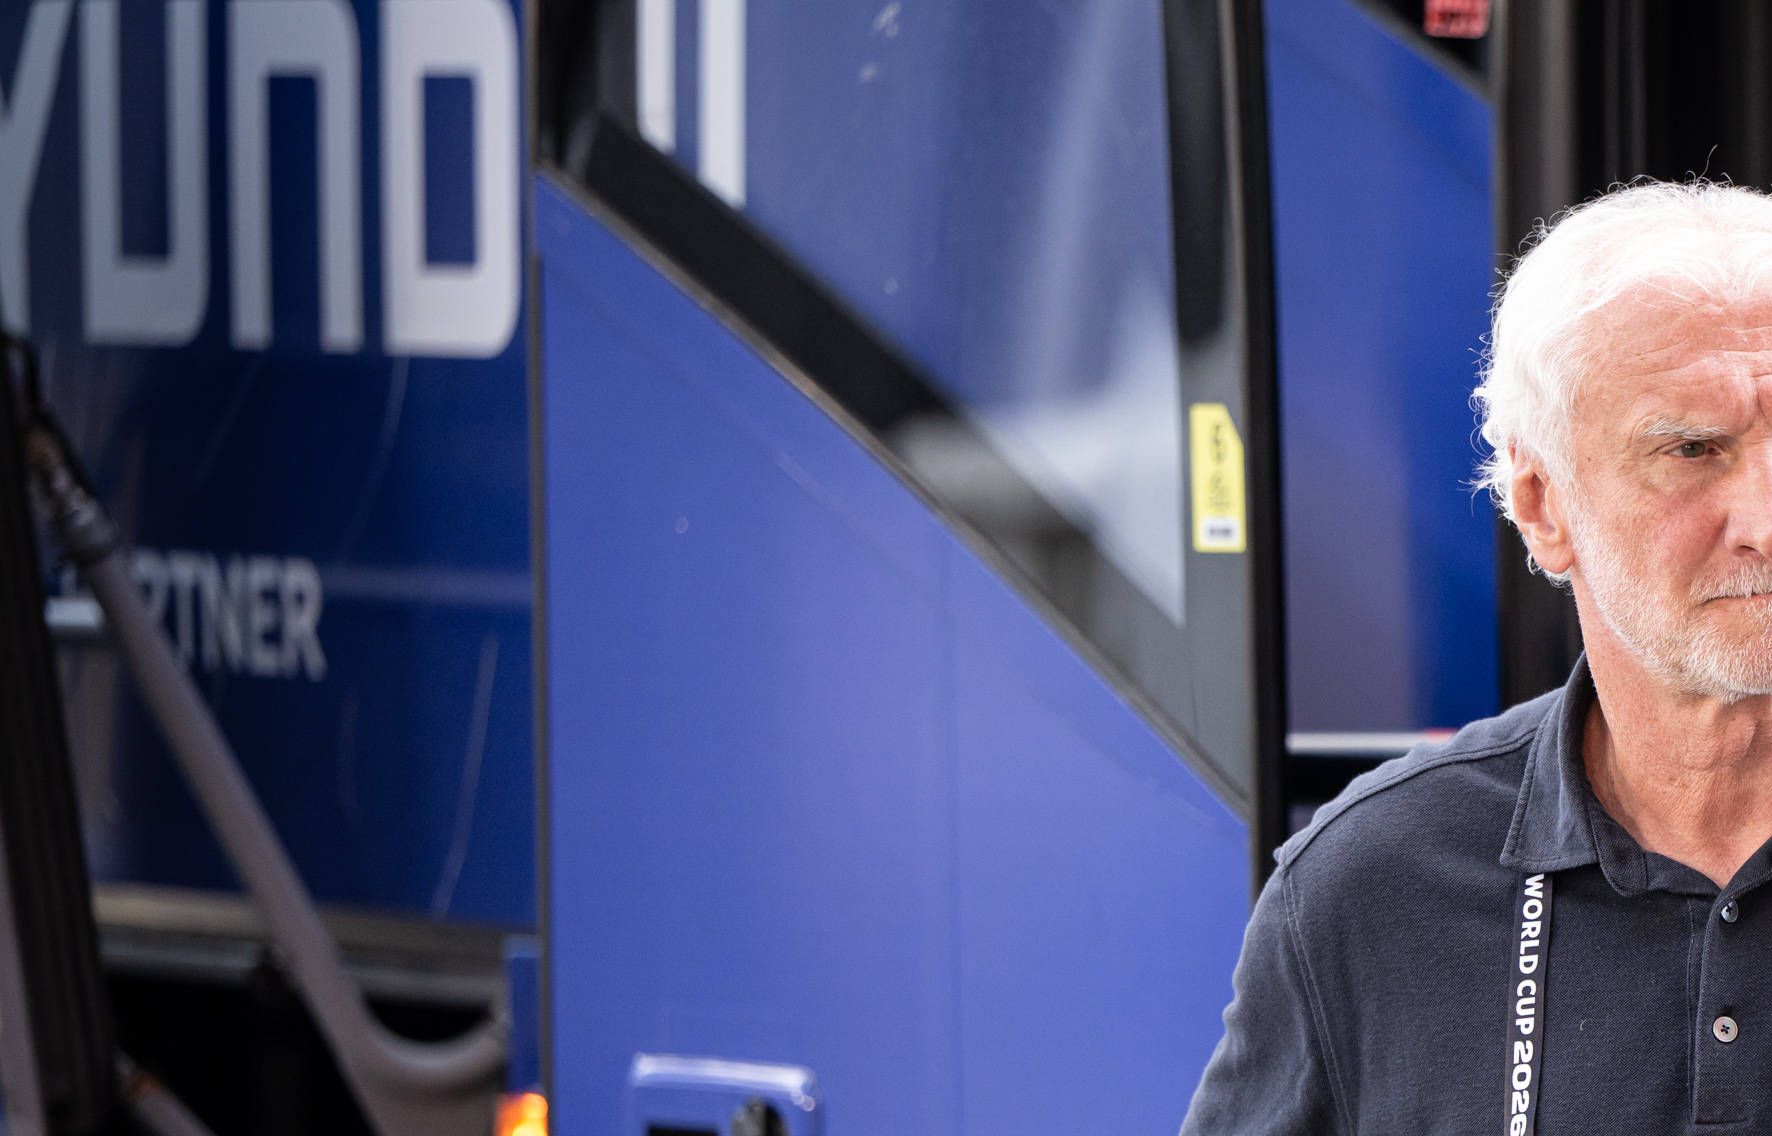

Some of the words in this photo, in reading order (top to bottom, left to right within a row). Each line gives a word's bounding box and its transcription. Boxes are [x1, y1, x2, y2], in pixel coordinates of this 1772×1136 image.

[118, 550, 328, 684] RTNER
[1518, 873, 1545, 975] WORLD
[1515, 979, 1537, 1036] CUP
